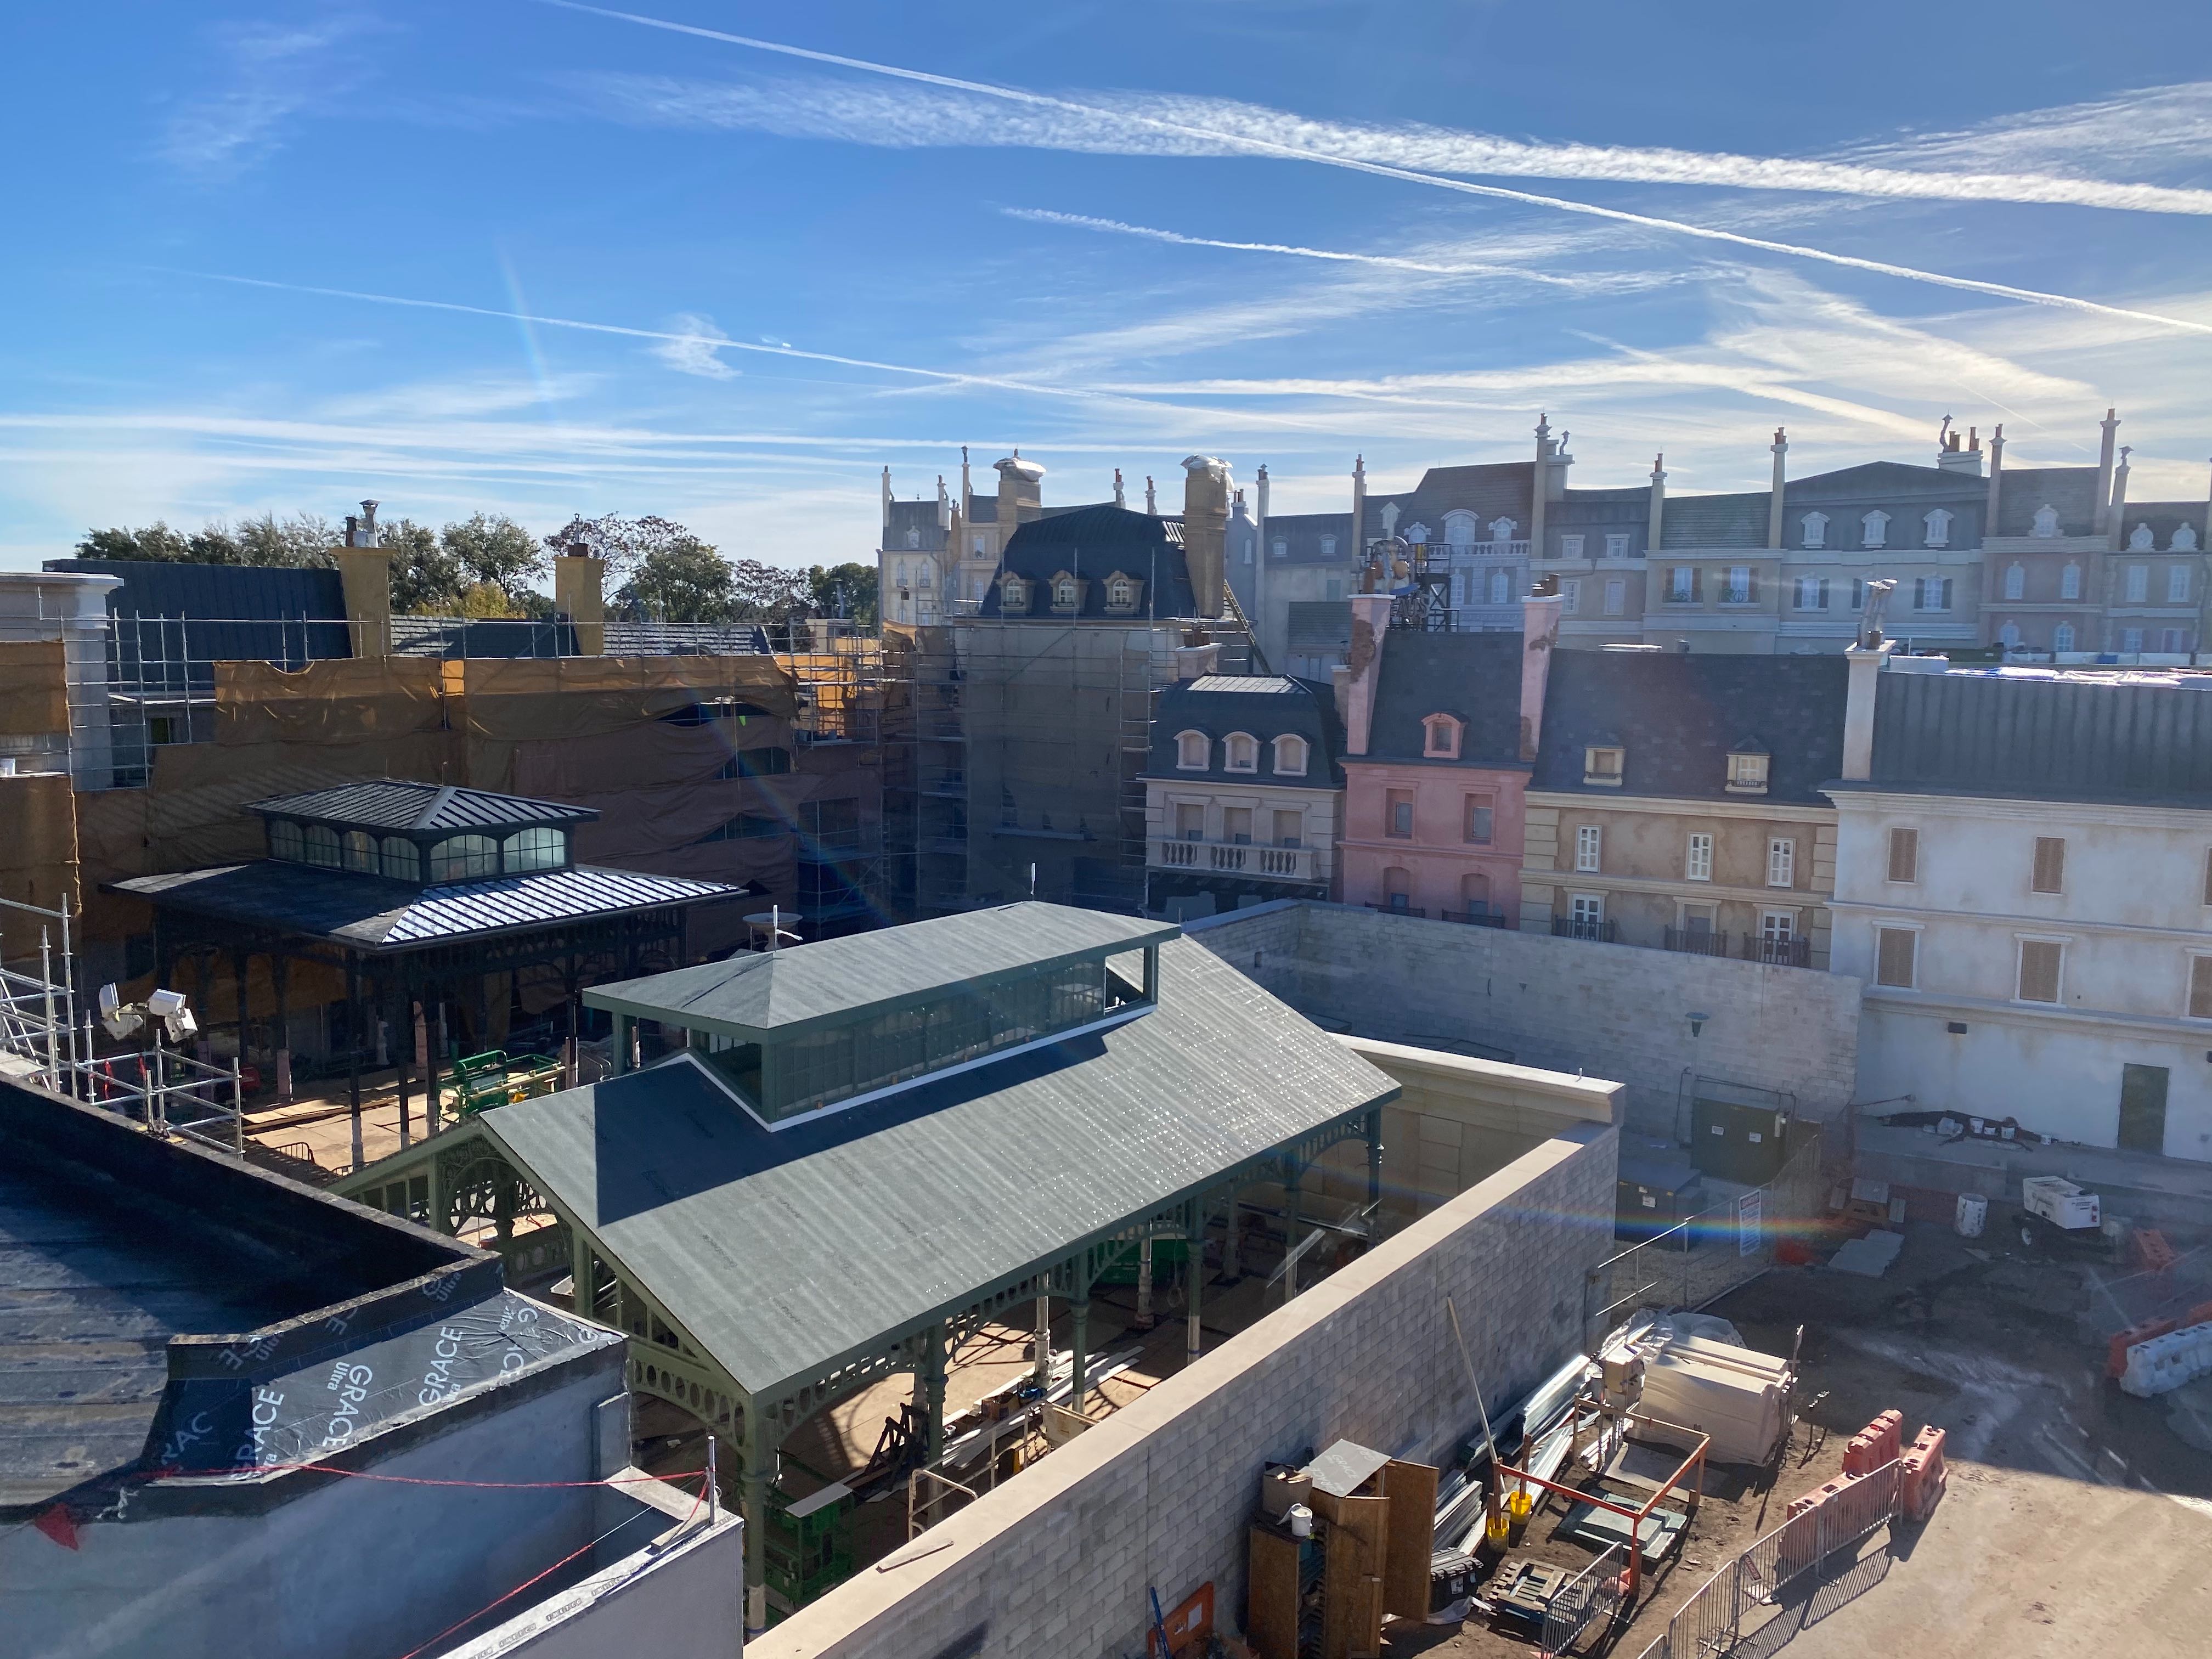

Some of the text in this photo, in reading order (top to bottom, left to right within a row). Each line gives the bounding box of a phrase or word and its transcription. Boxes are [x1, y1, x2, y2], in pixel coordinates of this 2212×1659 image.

[322, 1365, 373, 1447] GRACE
[327, 1362, 350, 1390] Ultra
[419, 1327, 462, 1406] GRACE
